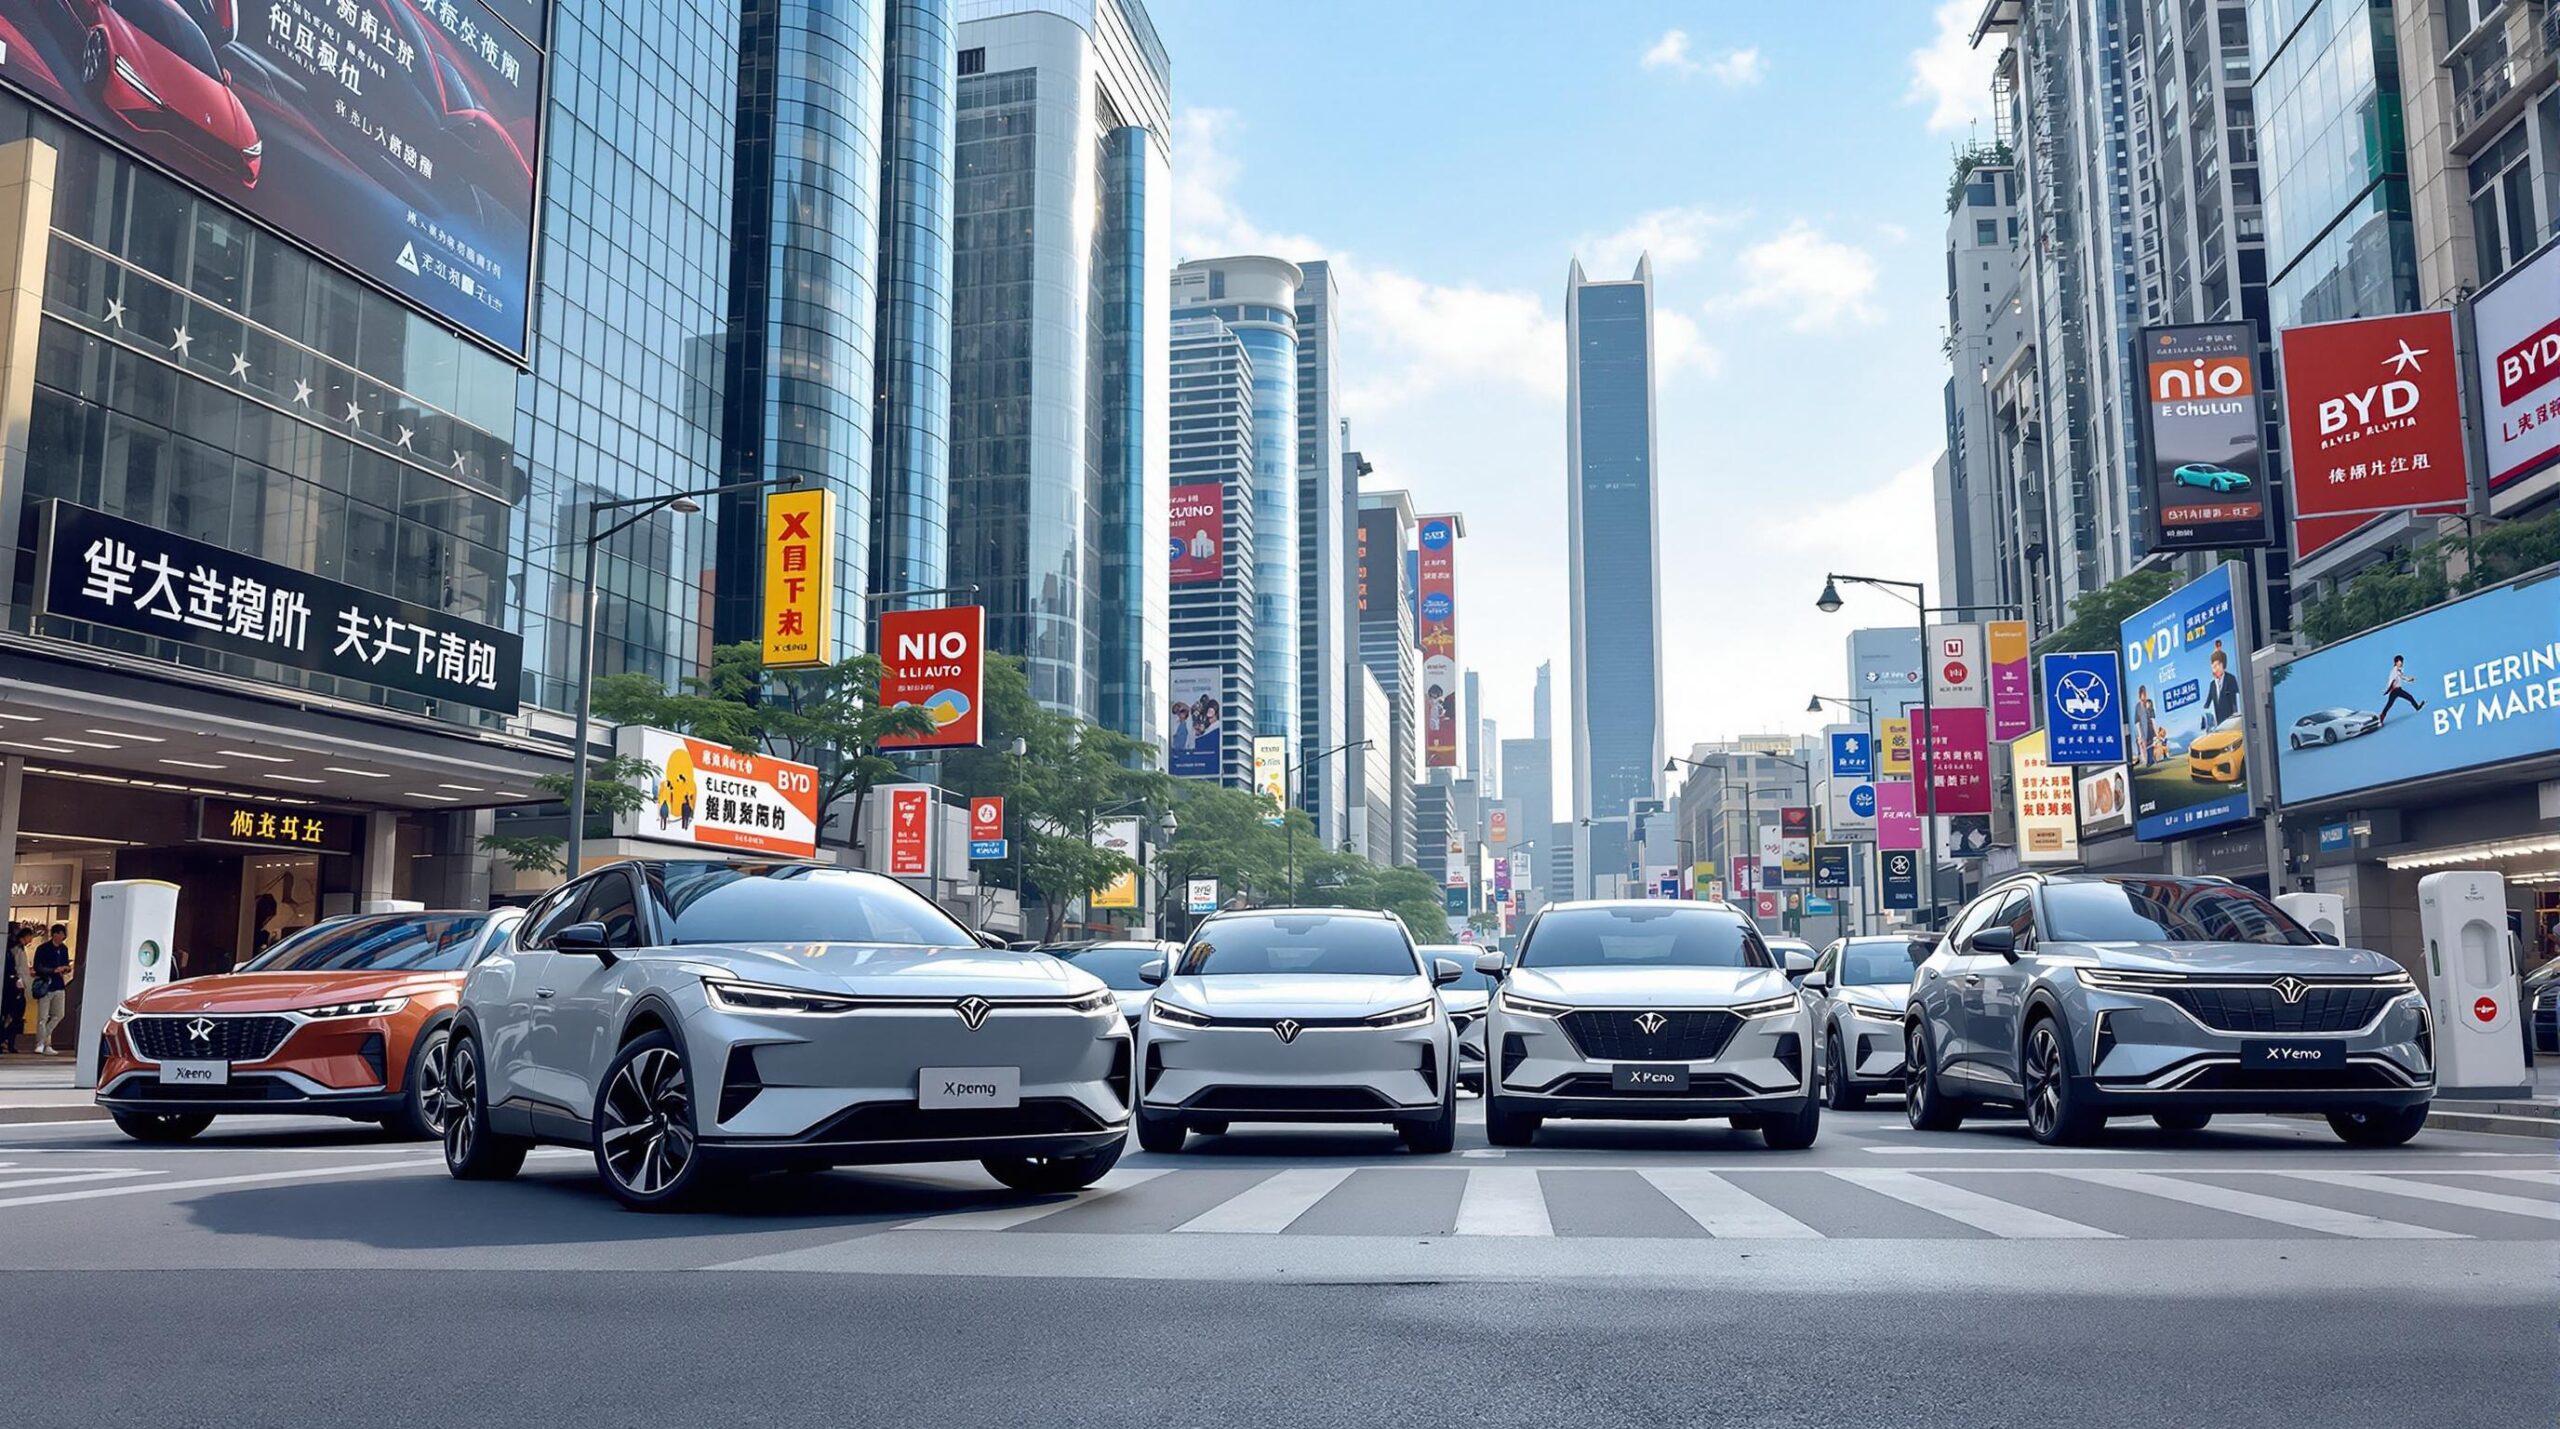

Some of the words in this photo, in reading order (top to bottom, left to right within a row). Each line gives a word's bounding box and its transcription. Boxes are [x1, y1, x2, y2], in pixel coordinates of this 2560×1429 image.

[2503, 334, 2560, 388] BYD
[2160, 358, 2243, 398] nio
[2319, 380, 2420, 435] BYD
[899, 631, 967, 661] NIO
[925, 665, 961, 677] AUTO
[2433, 703, 2466, 735] BY
[706, 777, 757, 798] ELECTER
[778, 769, 810, 793] BYD
